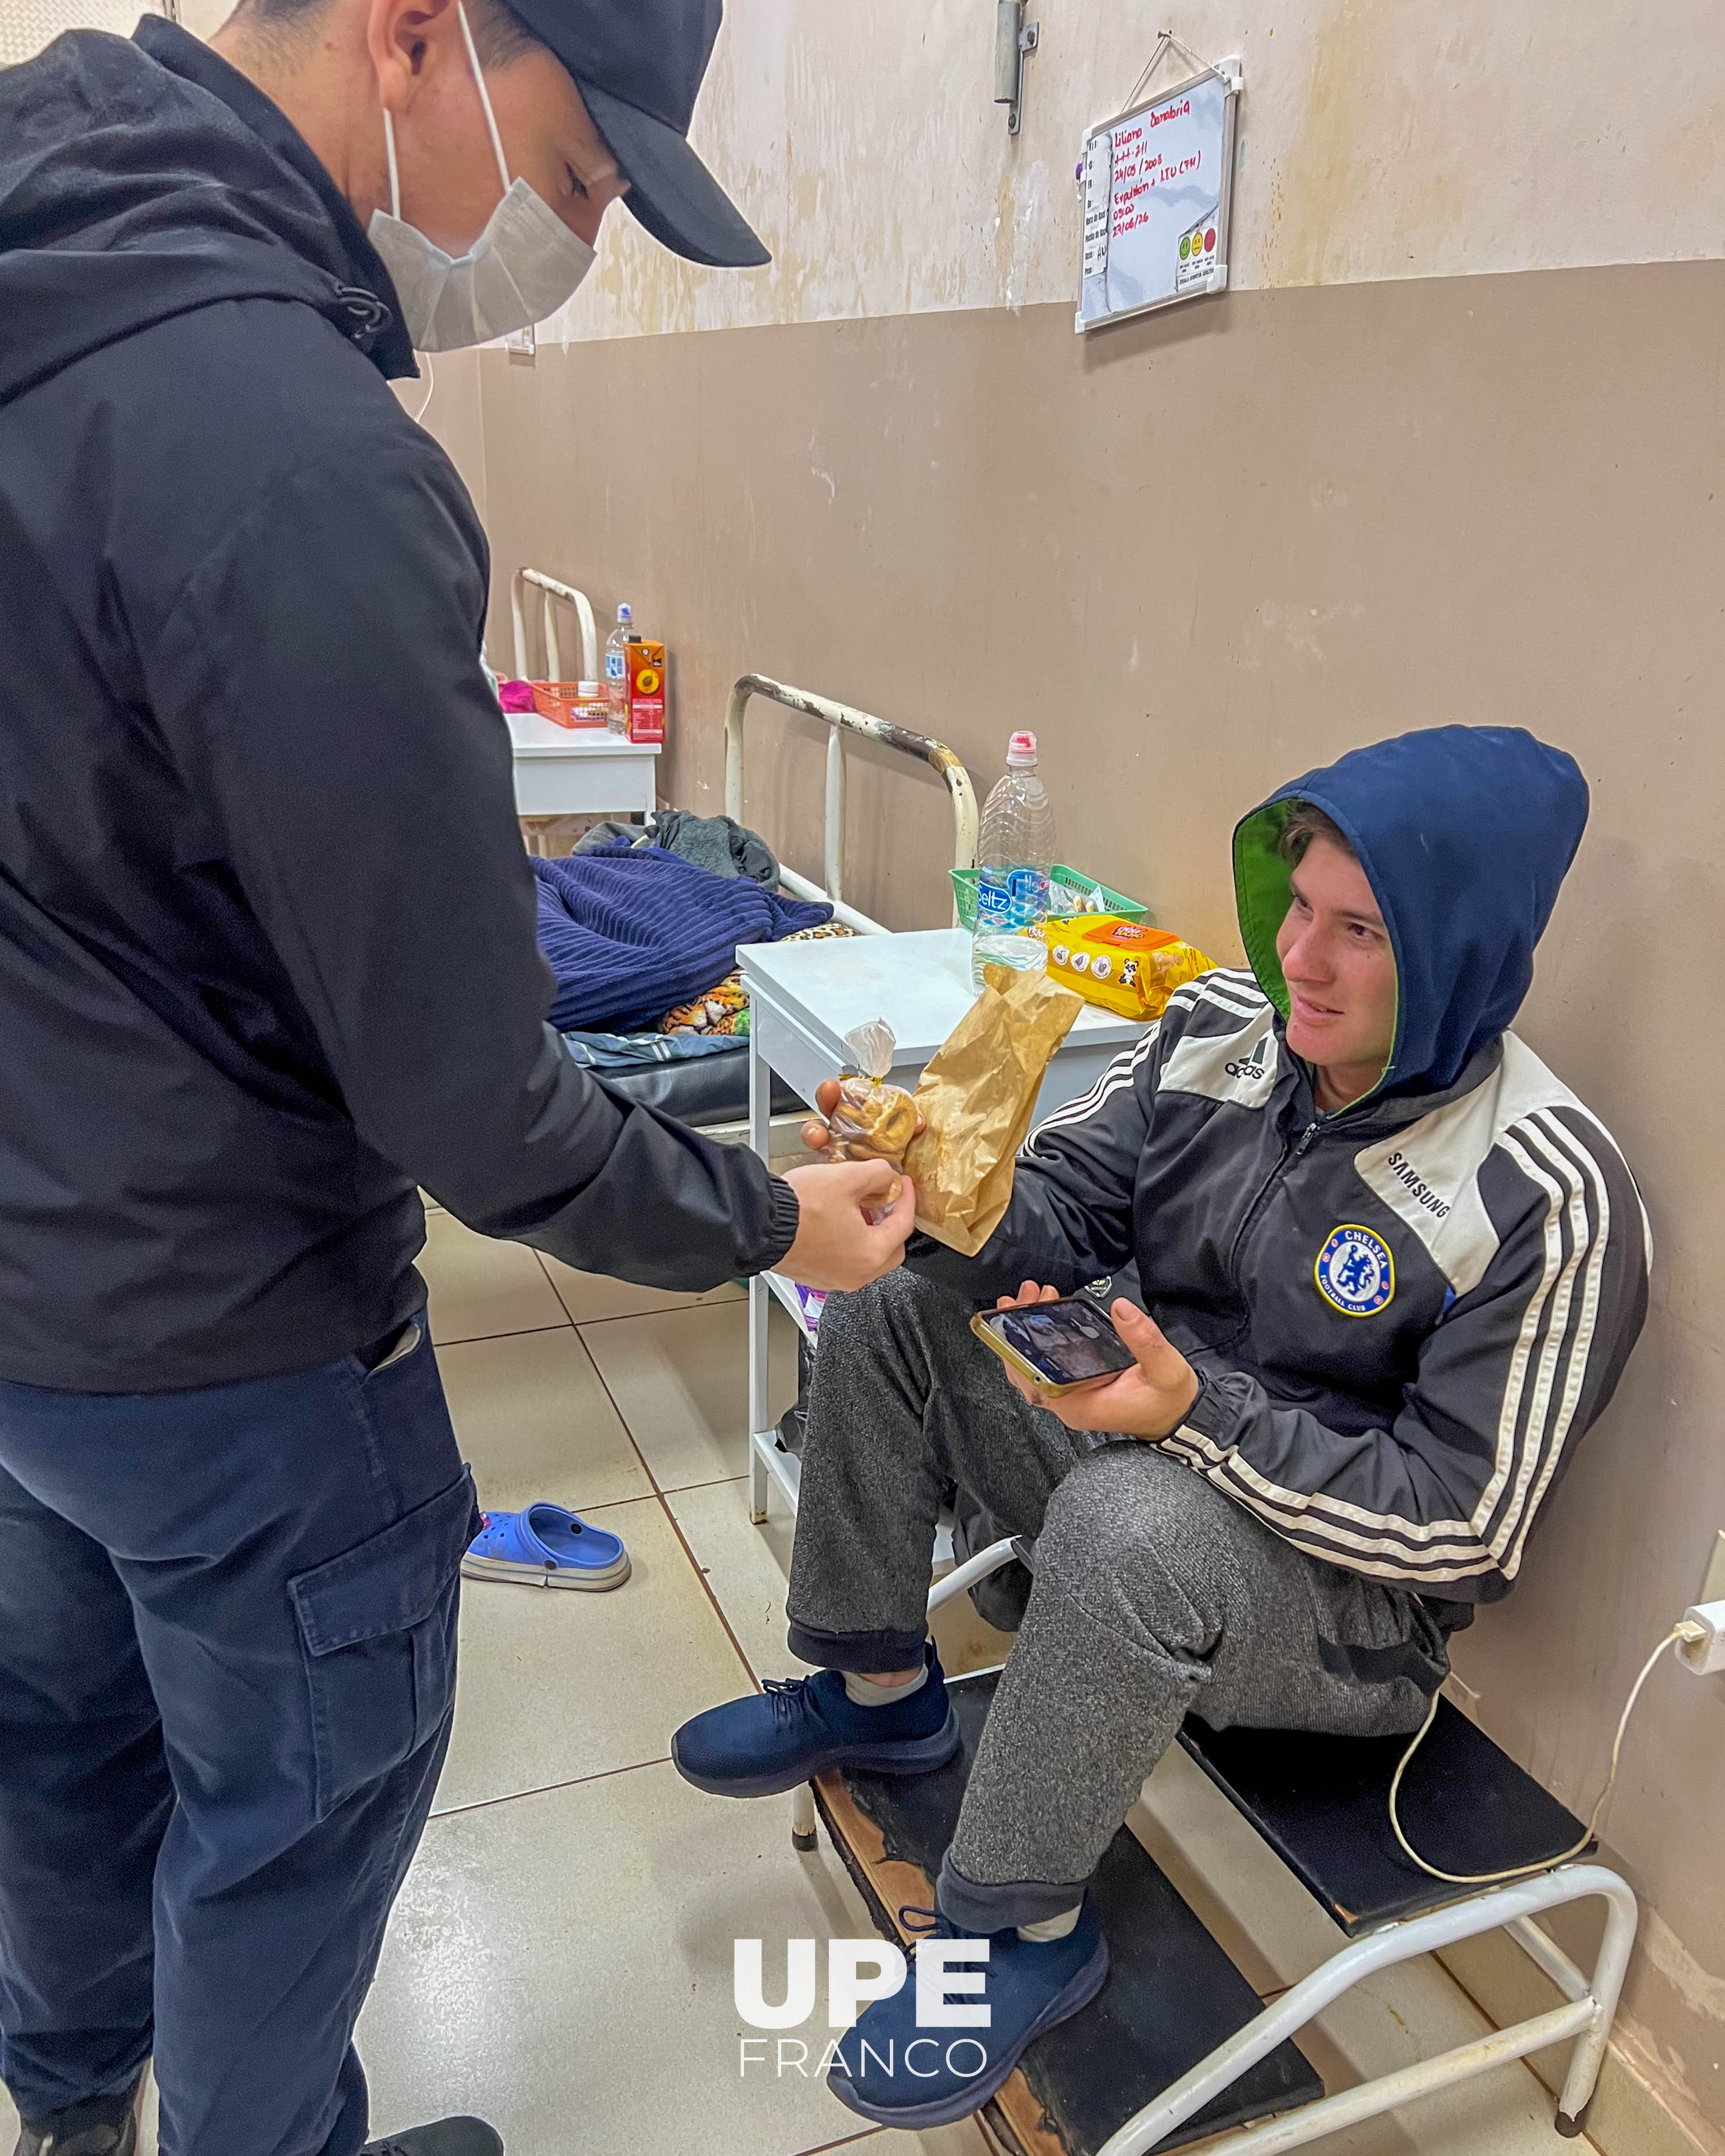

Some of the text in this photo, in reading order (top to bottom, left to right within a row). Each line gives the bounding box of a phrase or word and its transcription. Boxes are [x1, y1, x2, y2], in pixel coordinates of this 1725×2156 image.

[1388, 1152, 1451, 1218] SAMSUNG
[1345, 1230, 1388, 1269] CHELSEA
[1320, 1274, 1366, 1312] FOOTBALL CLUB
